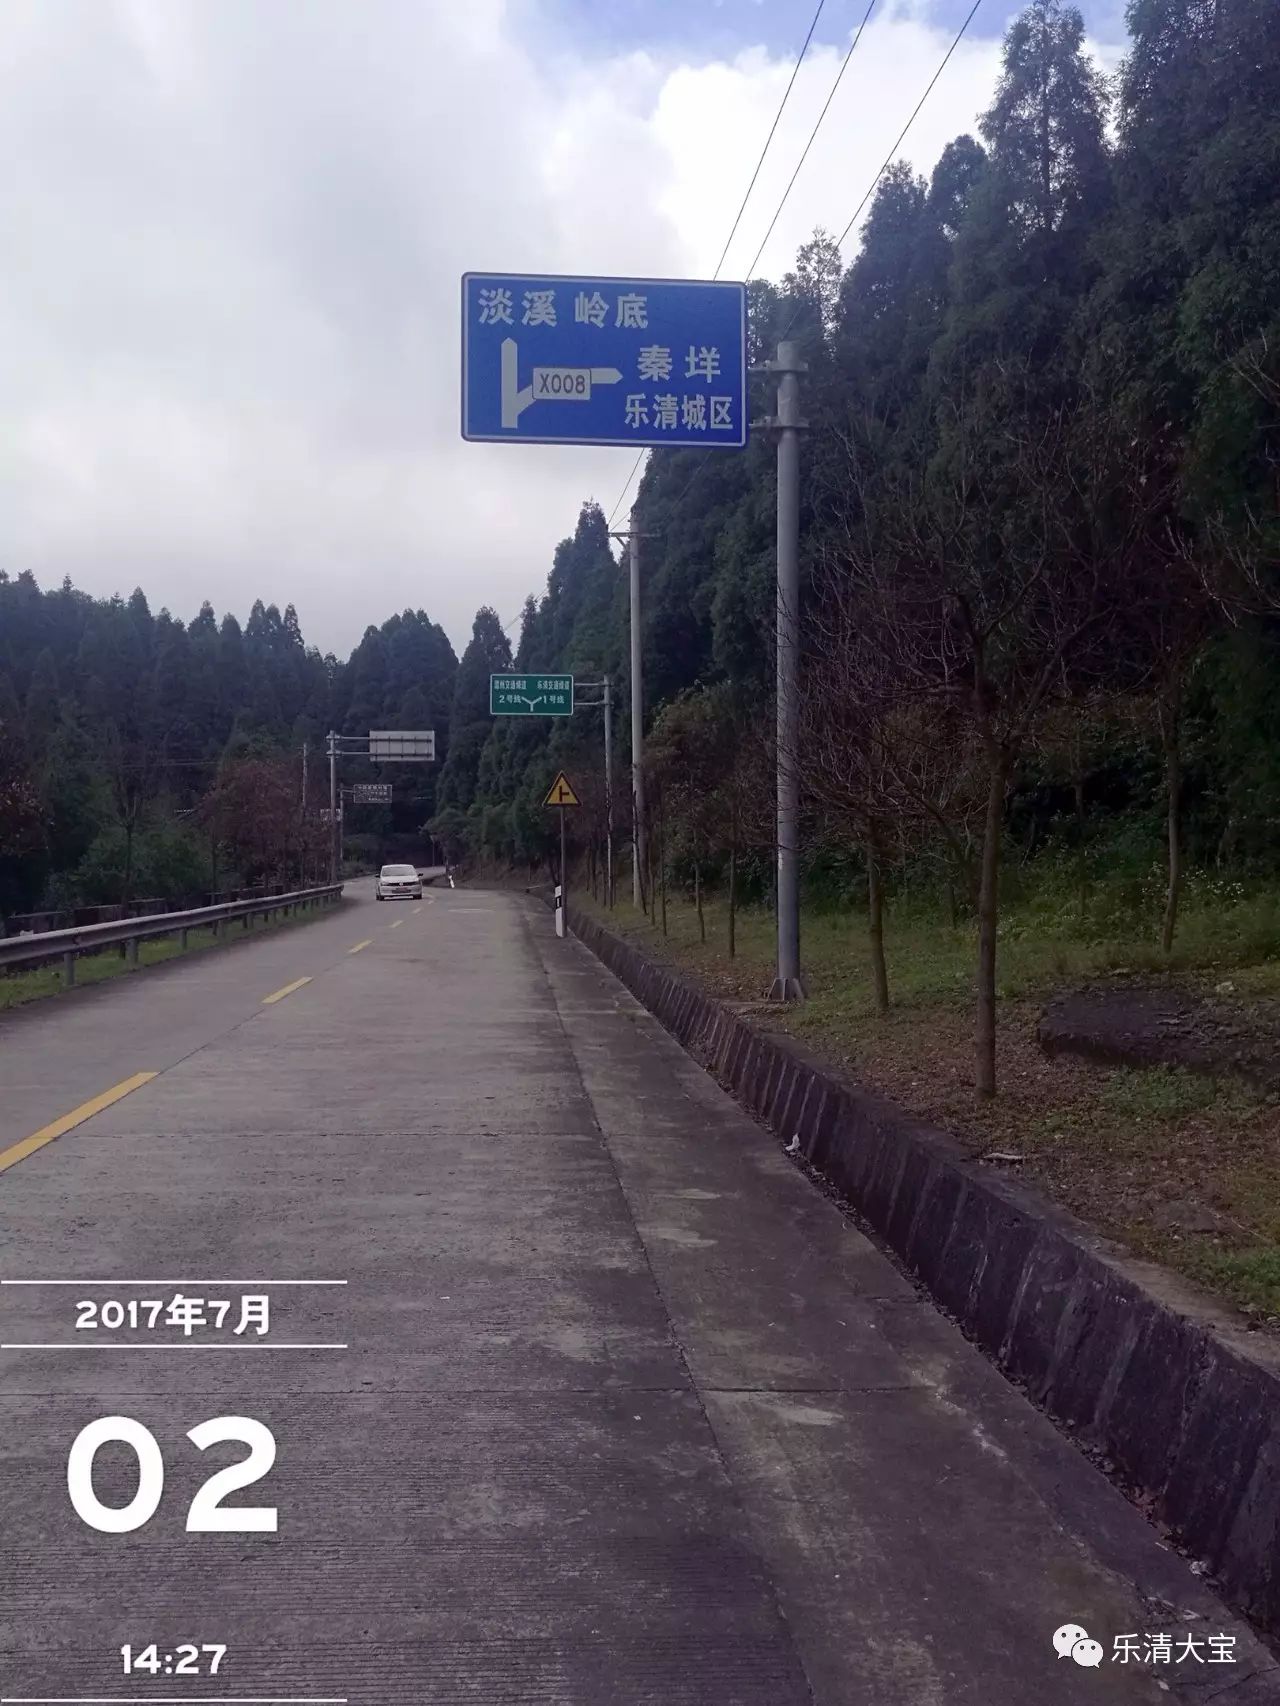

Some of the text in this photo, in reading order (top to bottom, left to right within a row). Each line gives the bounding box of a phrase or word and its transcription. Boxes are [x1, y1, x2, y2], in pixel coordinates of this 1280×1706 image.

[478, 288, 649, 329] 淡溪 岭底
[539, 373, 586, 394] X008
[637, 344, 721, 384] 秦垟
[624, 393, 734, 431] 乐清城区
